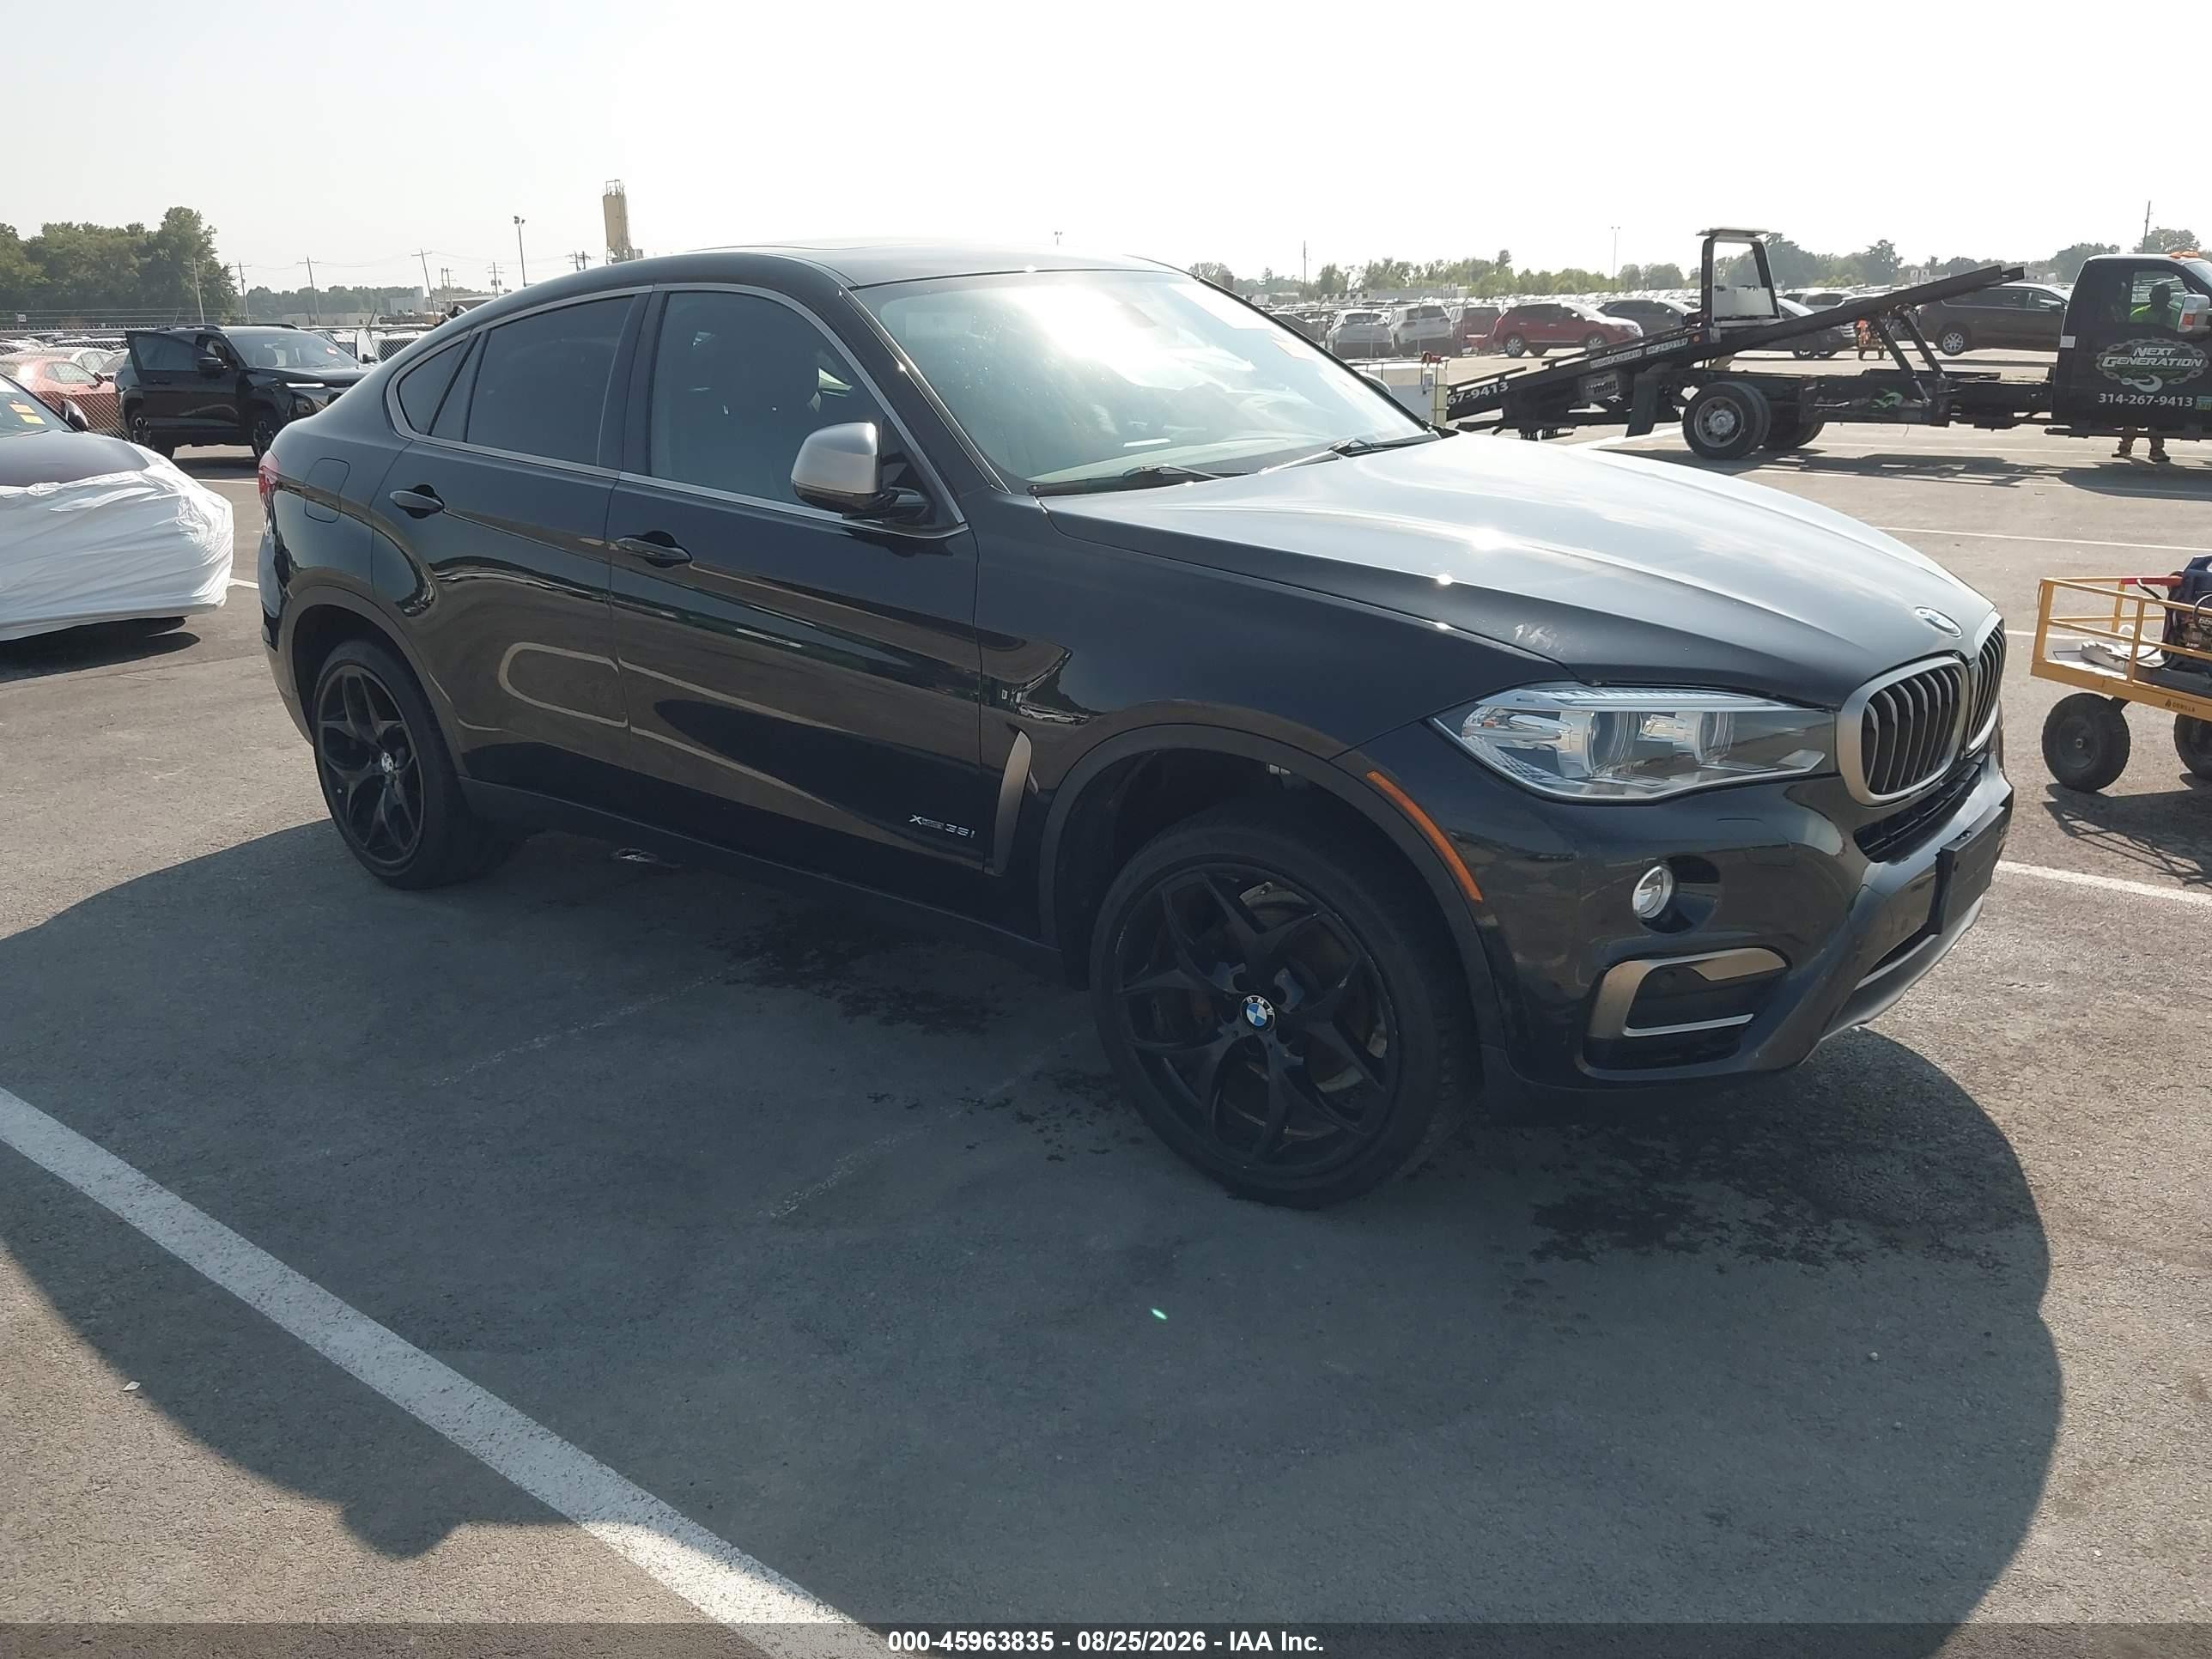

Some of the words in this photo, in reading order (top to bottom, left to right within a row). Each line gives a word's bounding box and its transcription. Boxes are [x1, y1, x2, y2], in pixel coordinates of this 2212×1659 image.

[2132, 347, 2176, 357] NEXT
[2101, 356, 2203, 368] GENERATION
[2098, 393, 2193, 407] 314-267-9413
[1246, 996, 1273, 1016] BMW
